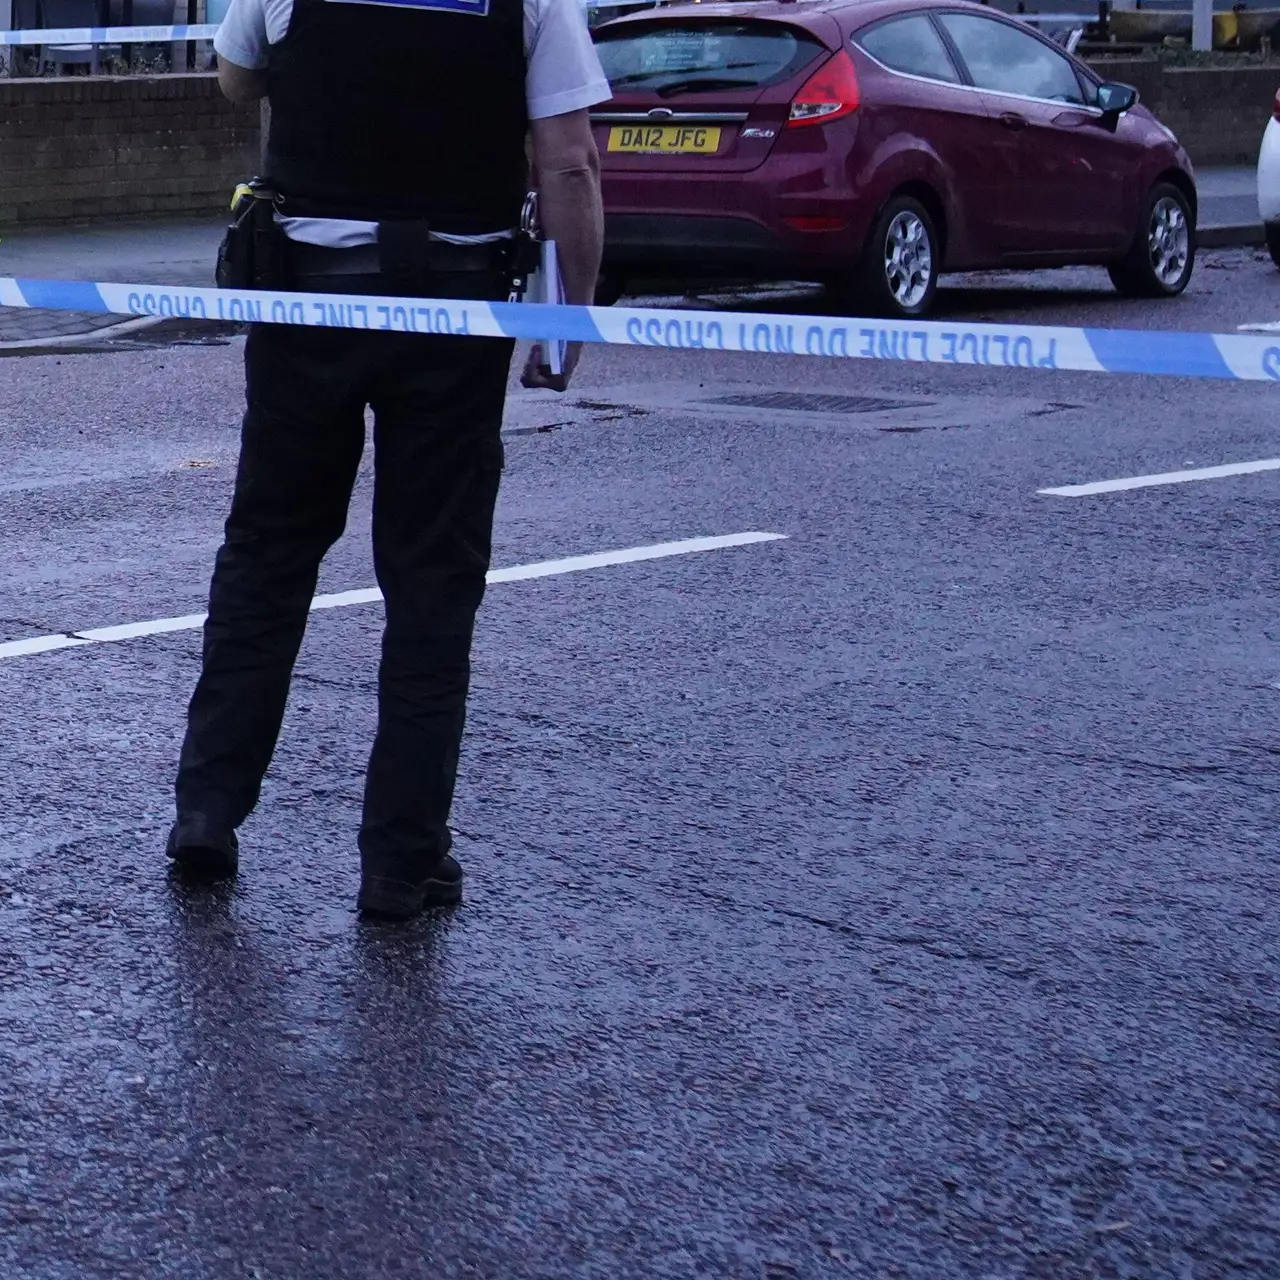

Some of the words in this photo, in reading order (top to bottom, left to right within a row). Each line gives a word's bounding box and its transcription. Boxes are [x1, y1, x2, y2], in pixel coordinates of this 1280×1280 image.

[619, 129, 663, 148] DA12
[668, 129, 706, 148] JFG
[626, 316, 726, 349] CROSS
[740, 322, 795, 354] NOT
[806, 326, 848, 357] DO
[860, 329, 931, 362] LINE
[941, 332, 1057, 369] POLICE
